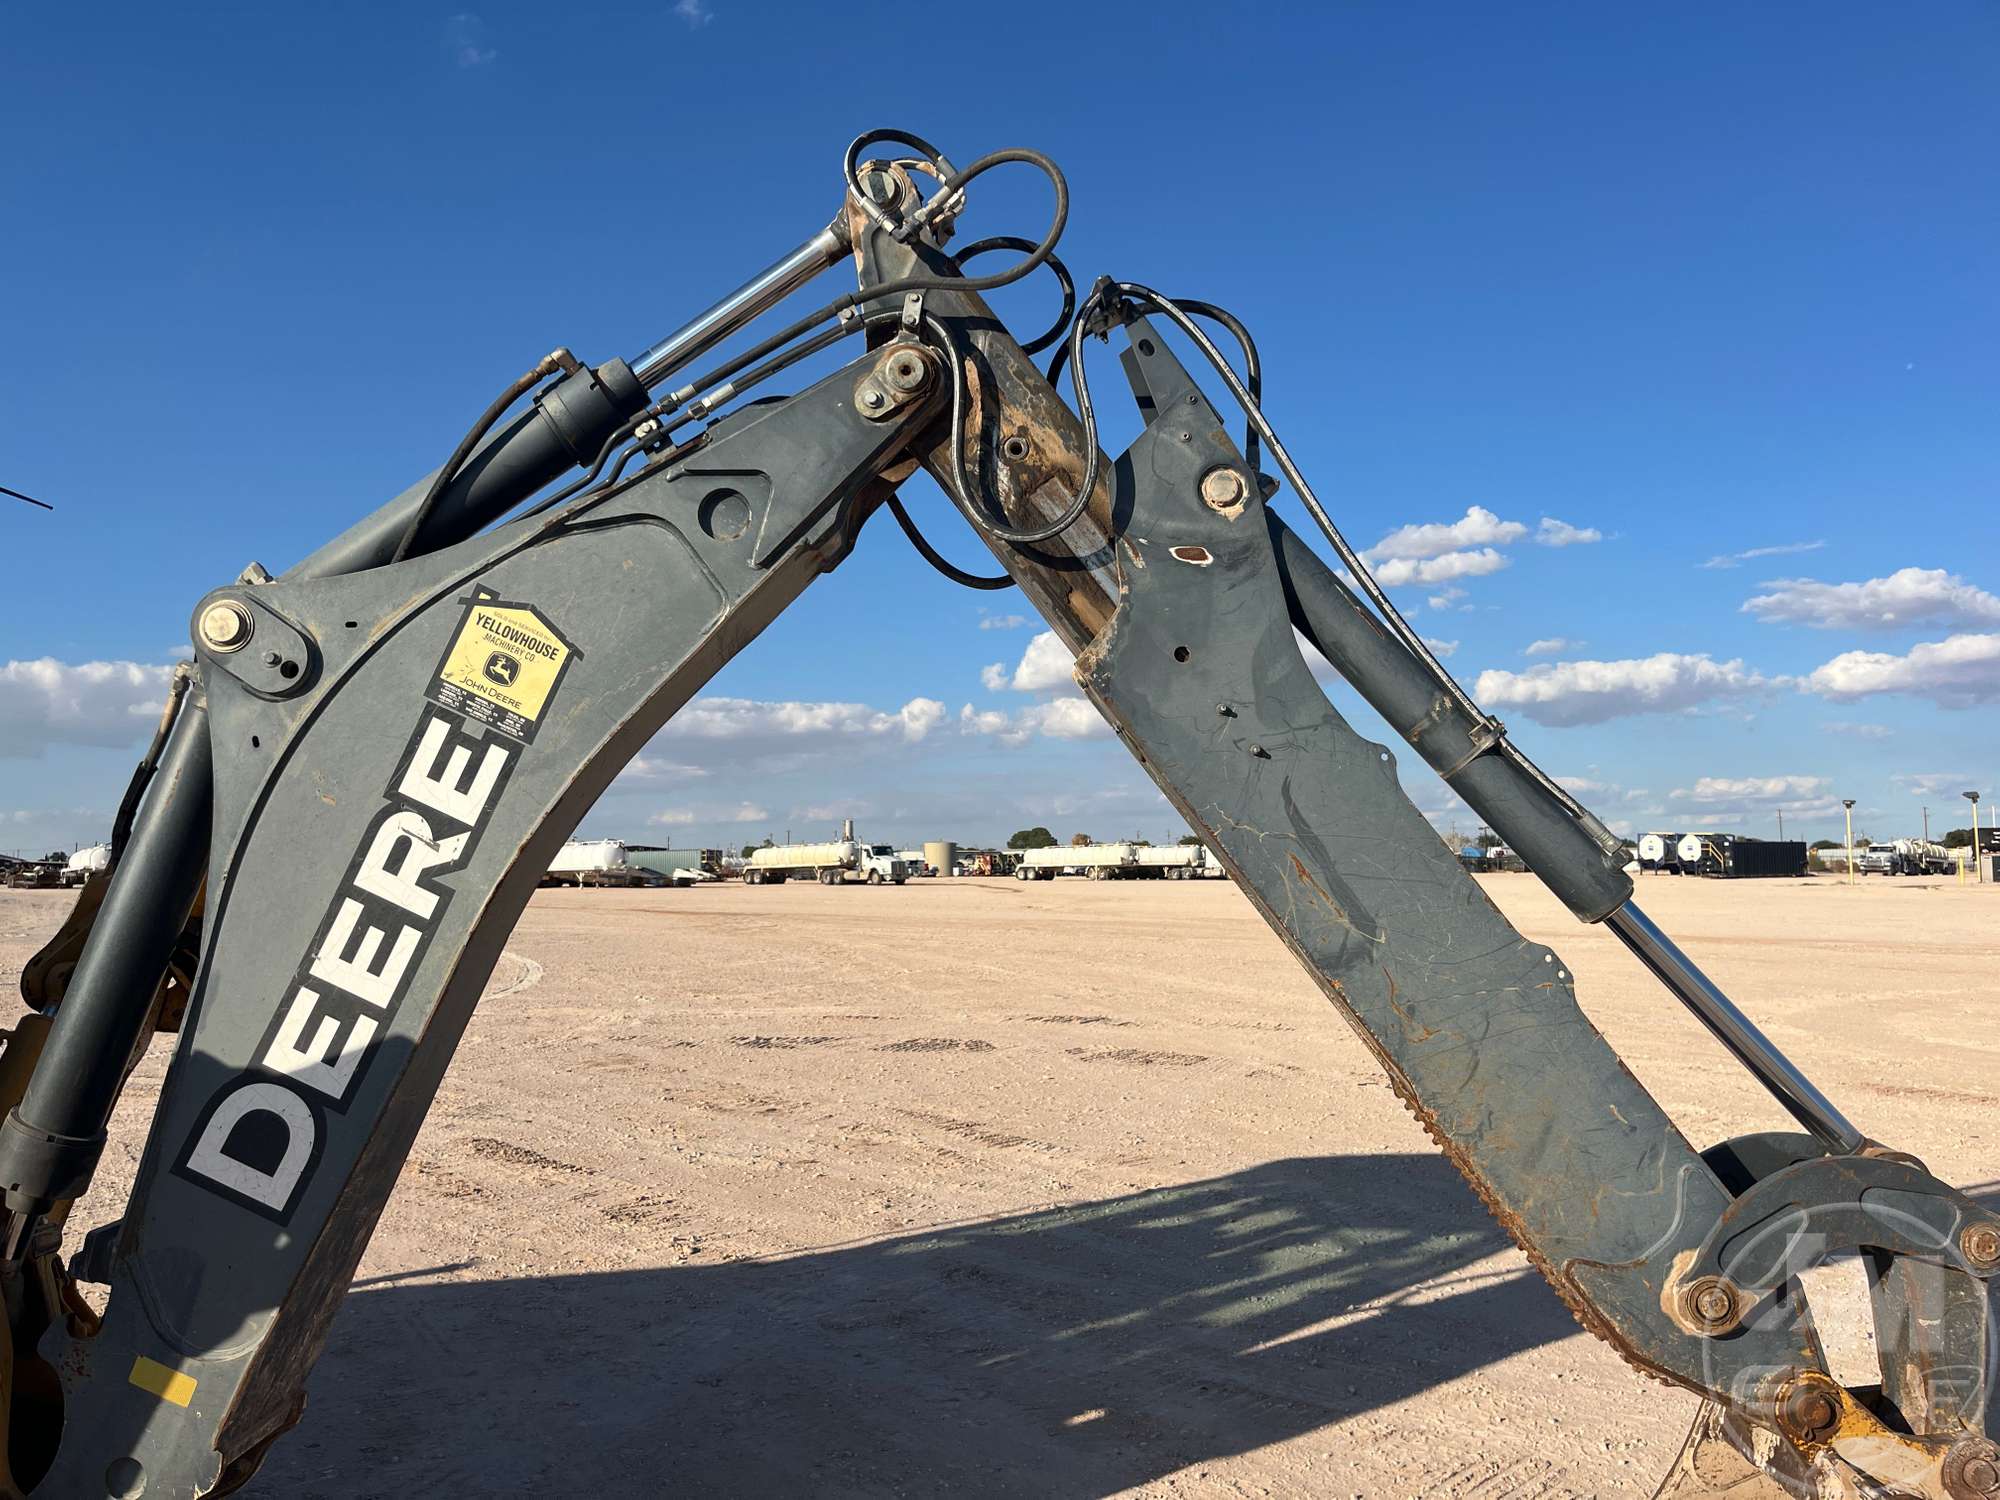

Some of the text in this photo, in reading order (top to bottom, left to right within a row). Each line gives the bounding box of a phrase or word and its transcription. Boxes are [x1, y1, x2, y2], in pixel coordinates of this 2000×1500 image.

[476, 612, 560, 661] YELLOWHOUSE
[483, 632, 525, 657] MACHINERY
[459, 676, 488, 693] JOHN
[488, 686, 522, 710] DEERE
[186, 716, 510, 1212] DEERE
